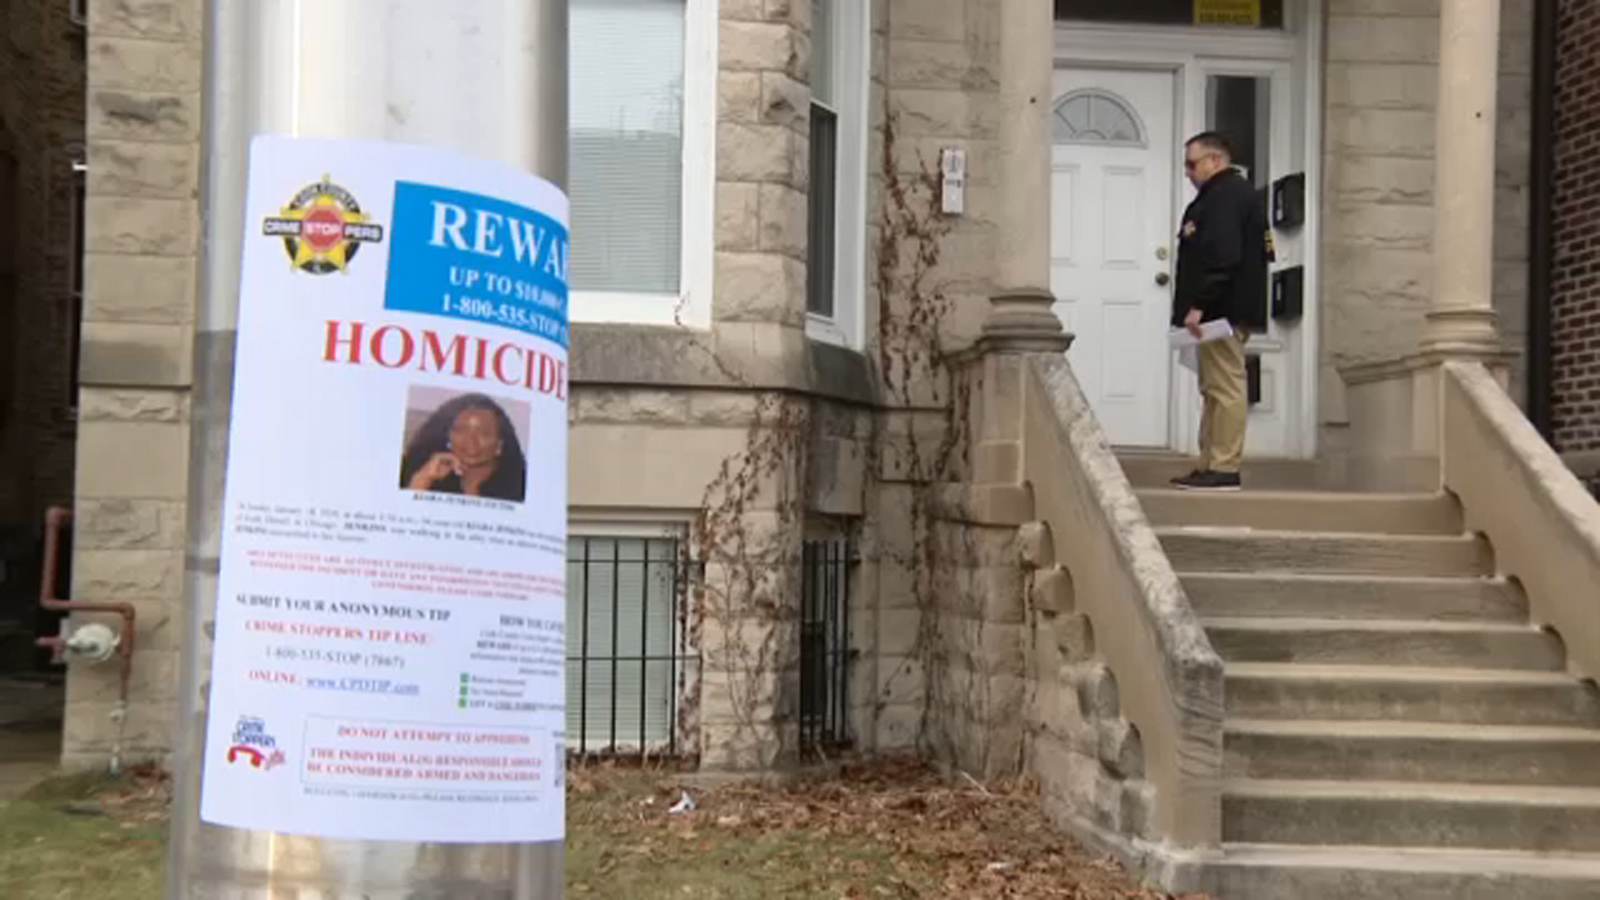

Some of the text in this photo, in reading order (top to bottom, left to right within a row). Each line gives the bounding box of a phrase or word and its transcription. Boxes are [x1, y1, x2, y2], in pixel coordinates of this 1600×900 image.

[305, 223, 342, 235] STOP
[429, 200, 567, 281] REWA
[450, 267, 479, 287] UP
[484, 271, 511, 295] TO
[322, 320, 566, 400] HOMICIDE
[236, 593, 451, 621] SUBMIT YOUR ANONYMOUS TIP
[245, 619, 287, 634] CRIME
[289, 621, 364, 641] STOPPERS
[368, 629, 393, 643] TIP
[338, 726, 358, 738] DO
[361, 727, 387, 741] NOT
[393, 729, 452, 744] ATTEMPT
[455, 732, 472, 745] TO
[310, 747, 335, 761] THE
[306, 761, 324, 774] BE
[326, 763, 412, 780] CONSIDERED
[416, 767, 462, 782] ARMED
